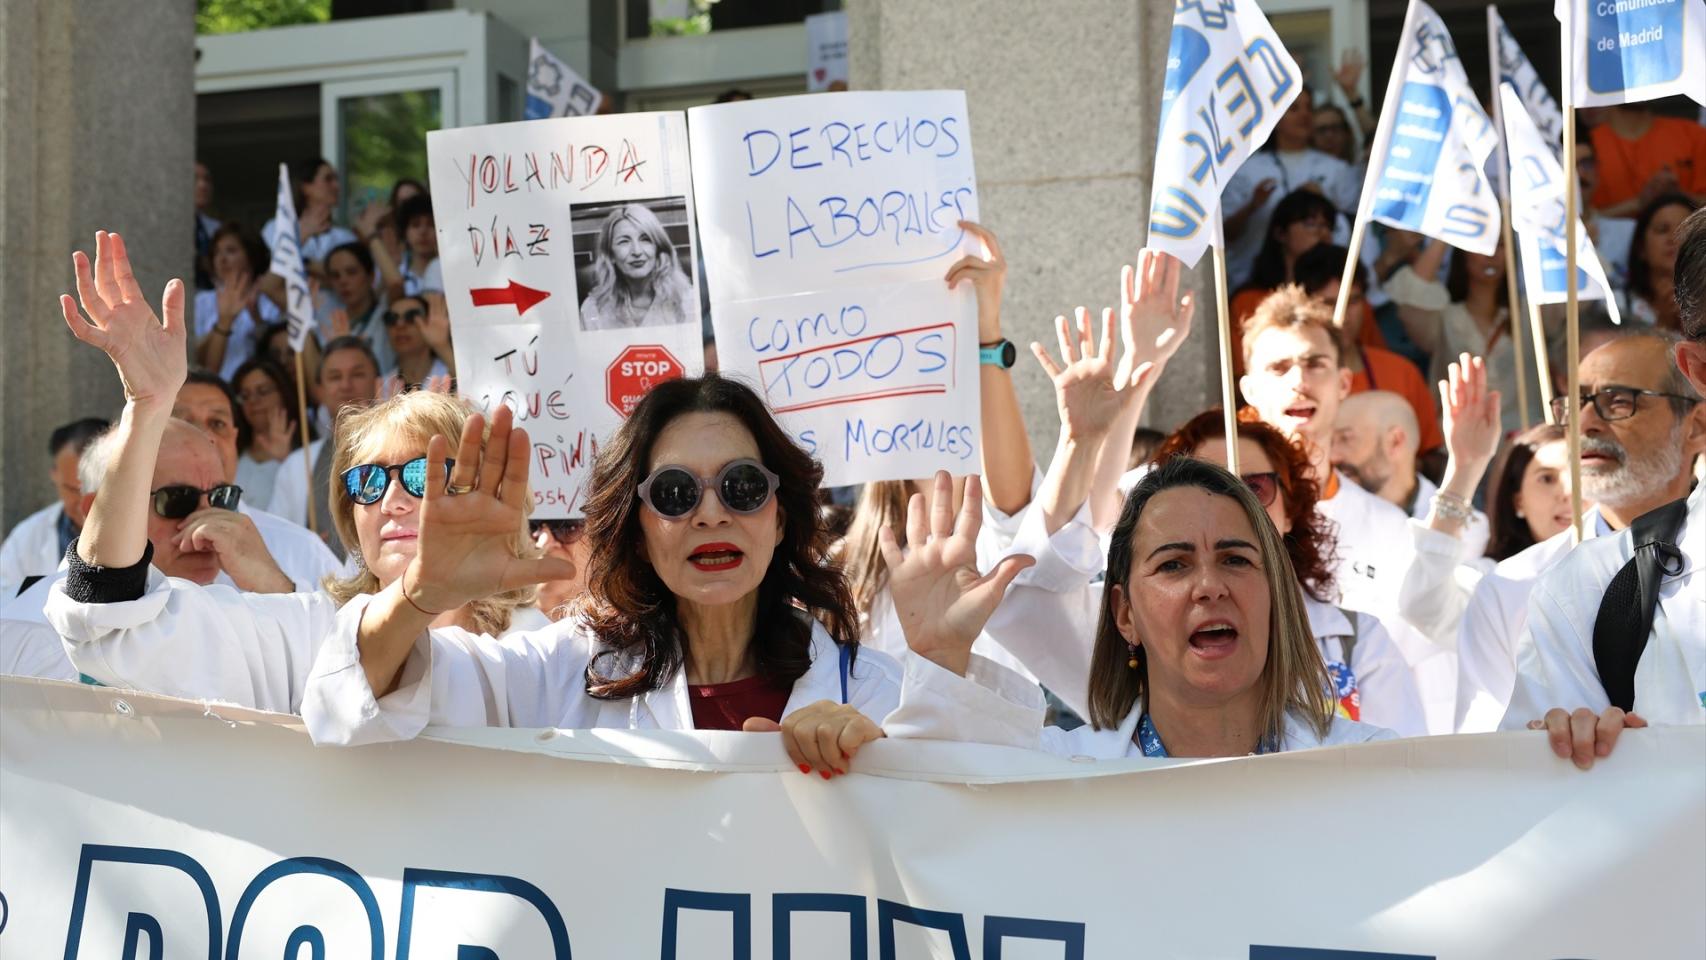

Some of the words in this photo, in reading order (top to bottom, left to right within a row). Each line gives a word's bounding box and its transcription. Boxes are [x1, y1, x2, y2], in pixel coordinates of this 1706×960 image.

[1596, 0, 1677, 17] Comuni
[1597, 36, 1615, 52] de
[1619, 24, 1663, 49] Madrid
[743, 116, 959, 177] DERECHOS
[453, 138, 647, 209] YOLANDA
[467, 214, 550, 268] DÍAZ
[745, 187, 973, 260] LABORALES
[494, 335, 538, 376] TÚ
[621, 361, 671, 377] STOP
[766, 334, 947, 397] TODOS
[845, 418, 974, 462] MORTALES
